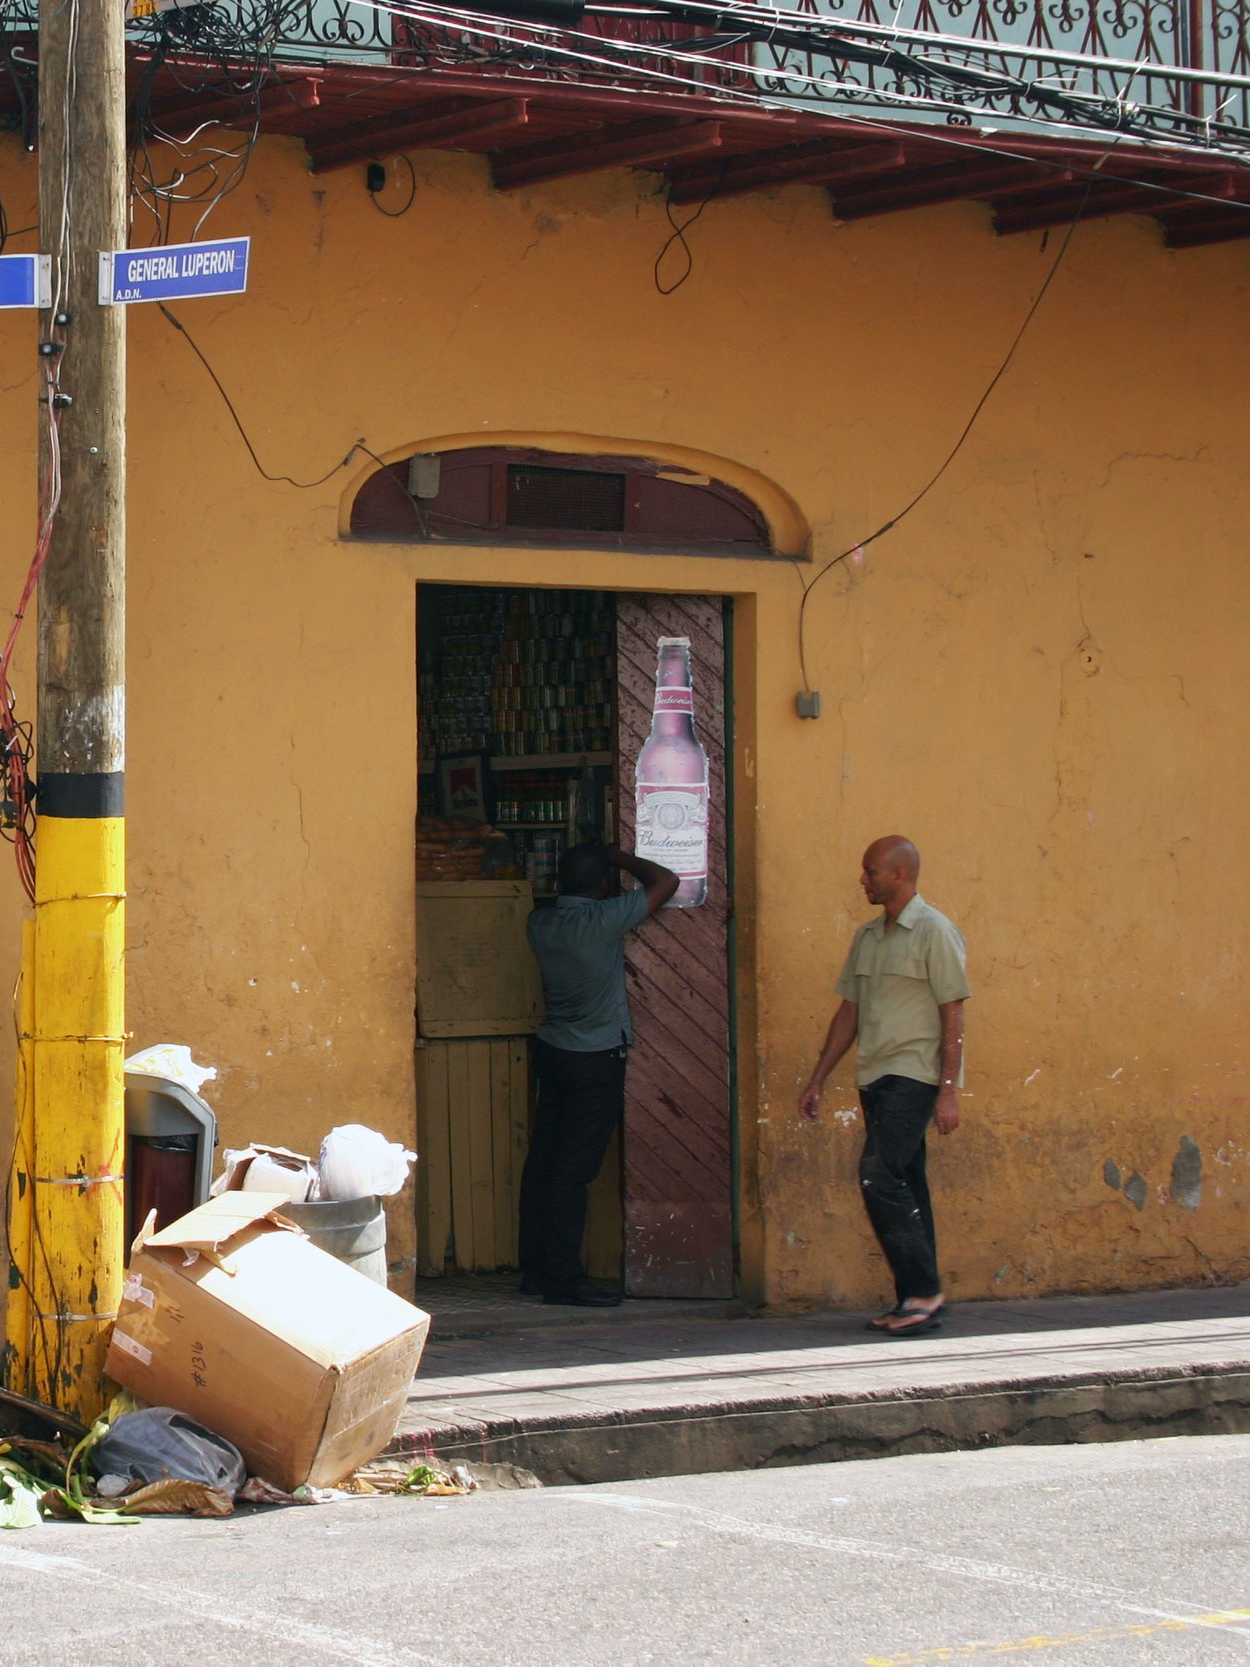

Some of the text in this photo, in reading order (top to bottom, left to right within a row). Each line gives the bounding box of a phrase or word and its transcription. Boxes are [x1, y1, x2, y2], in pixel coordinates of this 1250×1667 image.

[128, 249, 236, 283] GENERAL LUPERON
[115, 288, 143, 301] A.D.N.
[638, 829, 704, 848] Budweiser
